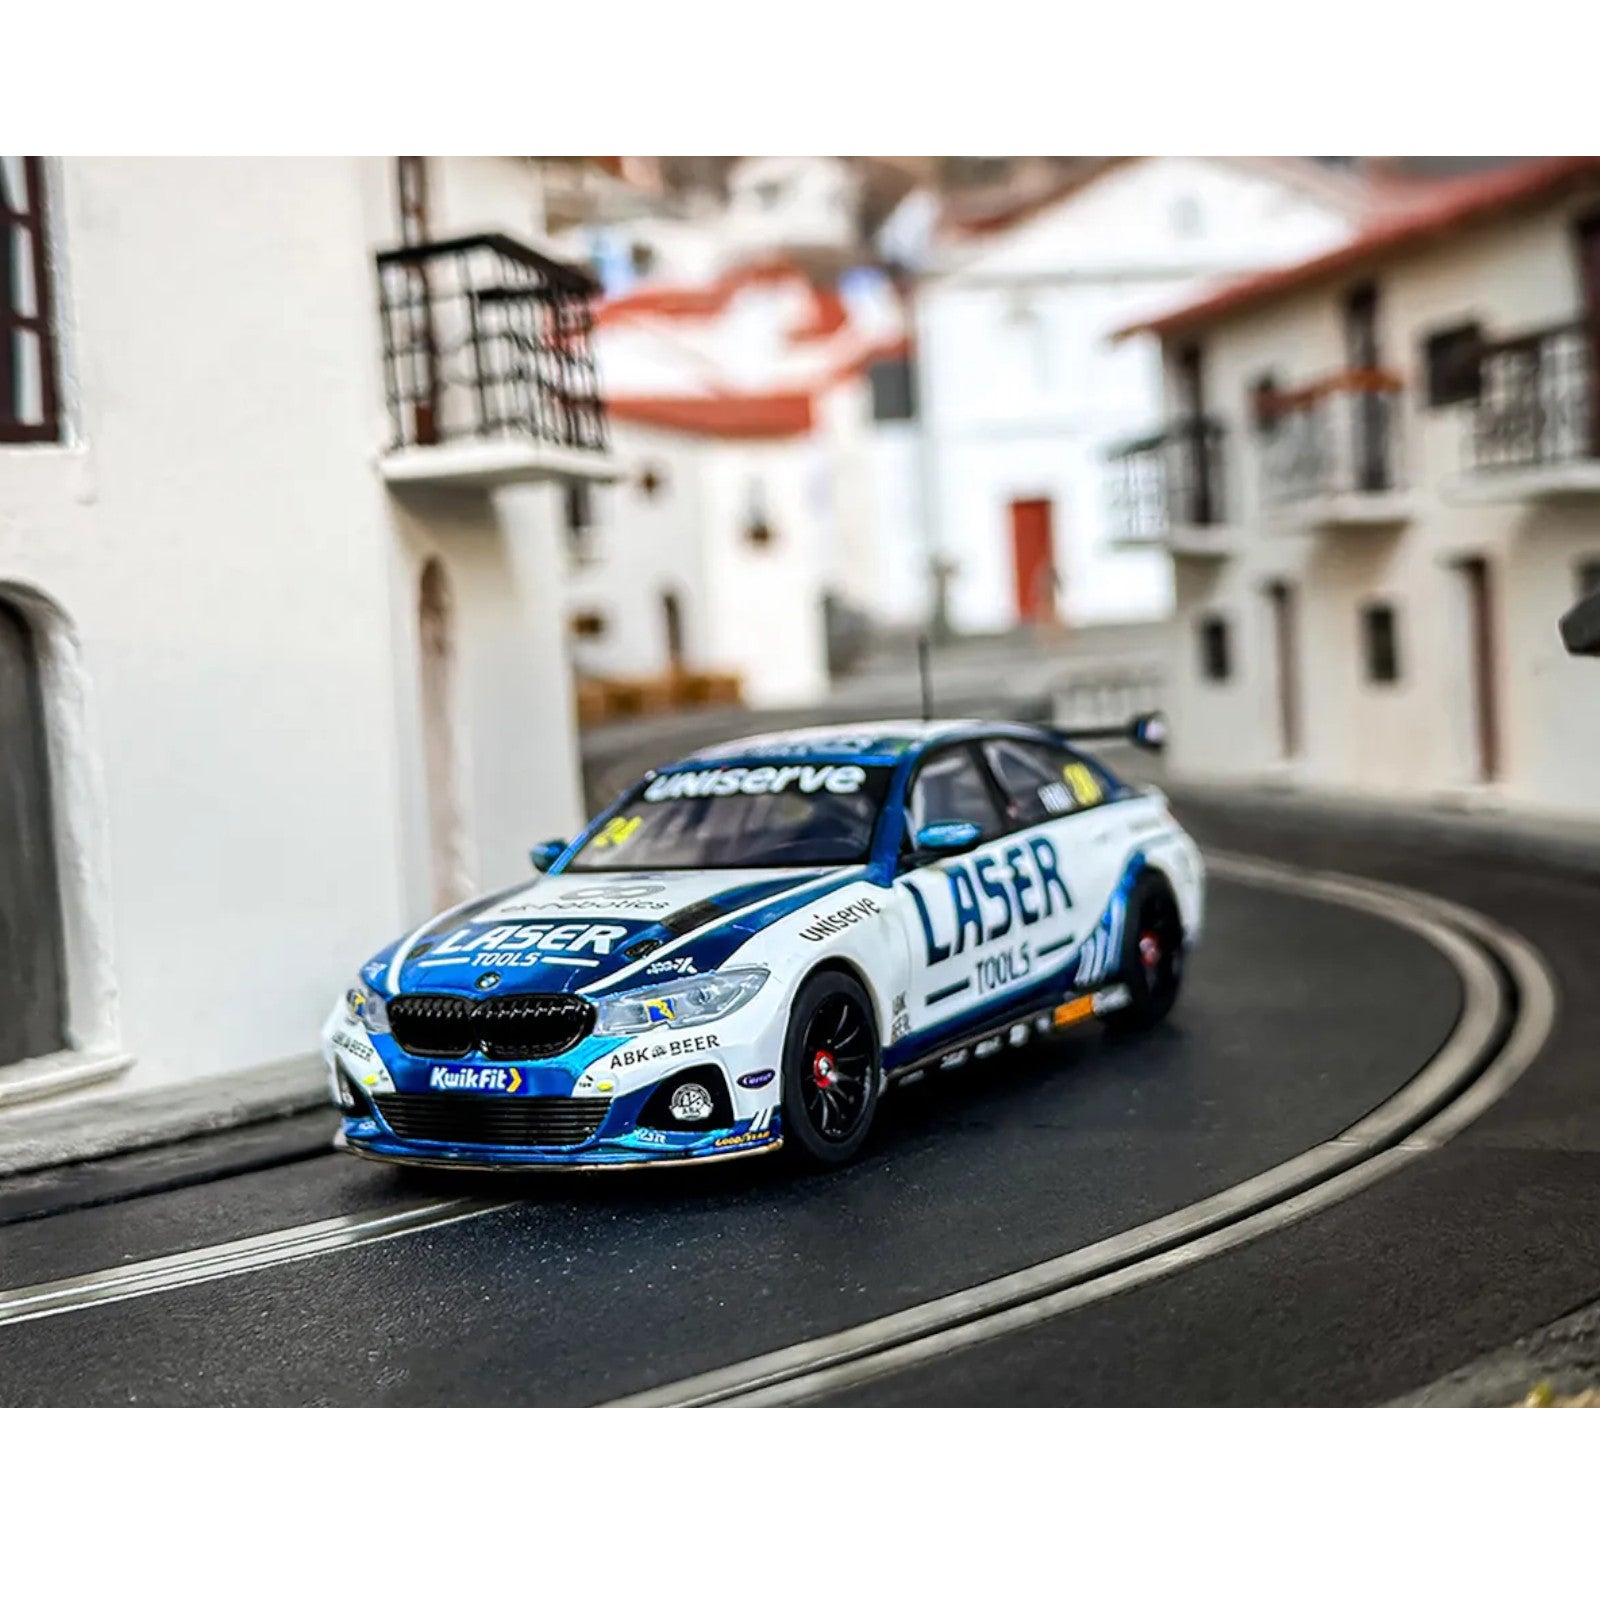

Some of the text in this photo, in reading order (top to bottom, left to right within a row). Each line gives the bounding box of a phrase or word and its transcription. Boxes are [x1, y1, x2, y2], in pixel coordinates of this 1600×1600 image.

[902, 837, 1073, 967] LASER
[432, 923, 628, 955] LASER
[470, 951, 542, 967] TOOLS
[974, 940, 1031, 997] TOOLS
[609, 1034, 720, 1070] ABK BEER
